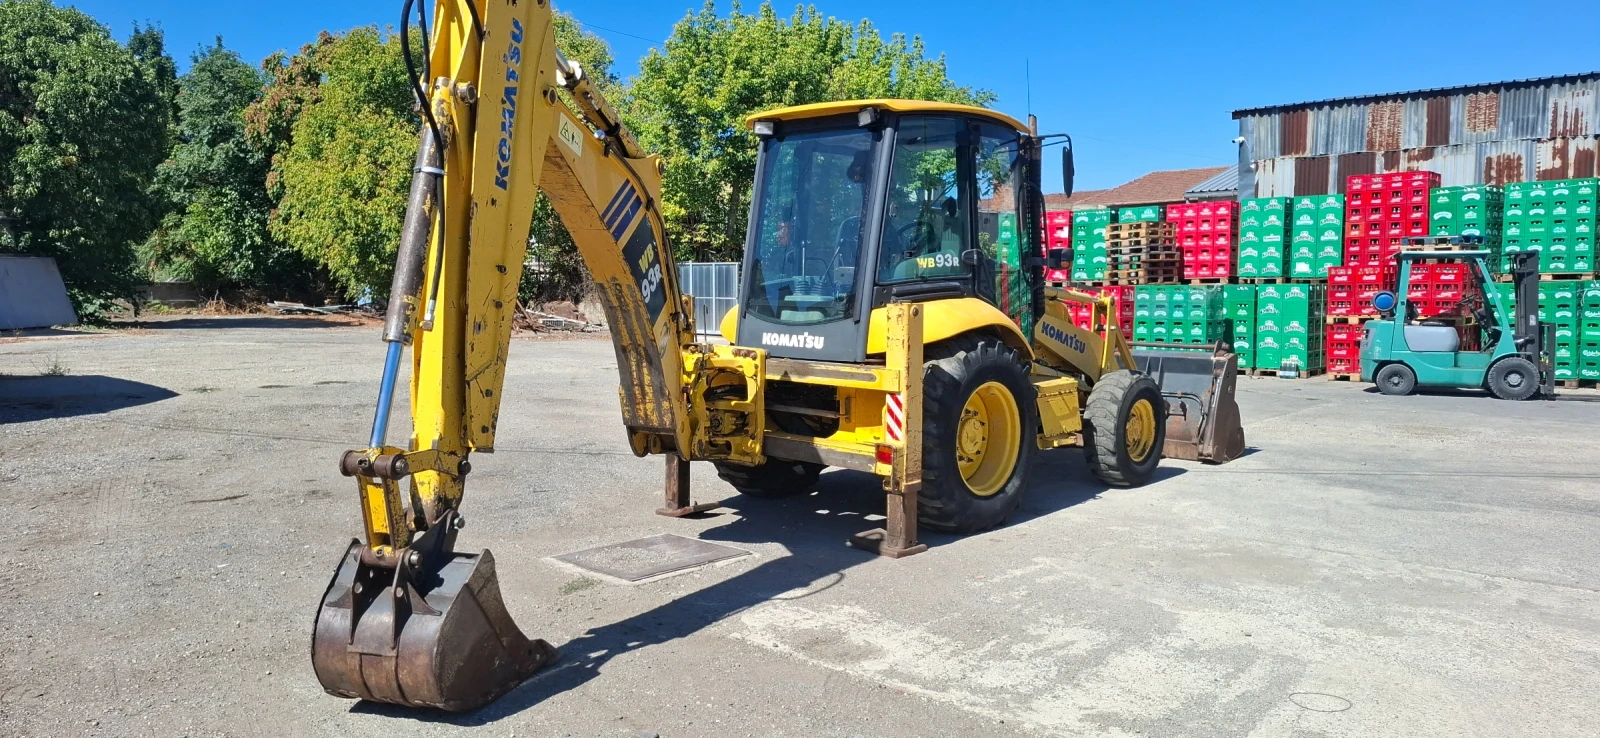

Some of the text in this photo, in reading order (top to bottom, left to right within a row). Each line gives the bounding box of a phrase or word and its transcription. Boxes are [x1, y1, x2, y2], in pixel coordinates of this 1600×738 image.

[495, 17, 524, 191] KOMATSU
[638, 243, 654, 273] WB
[641, 263, 662, 304] 93R
[762, 331, 825, 349] KOMATSU
[1041, 321, 1086, 354] KOMATSU
